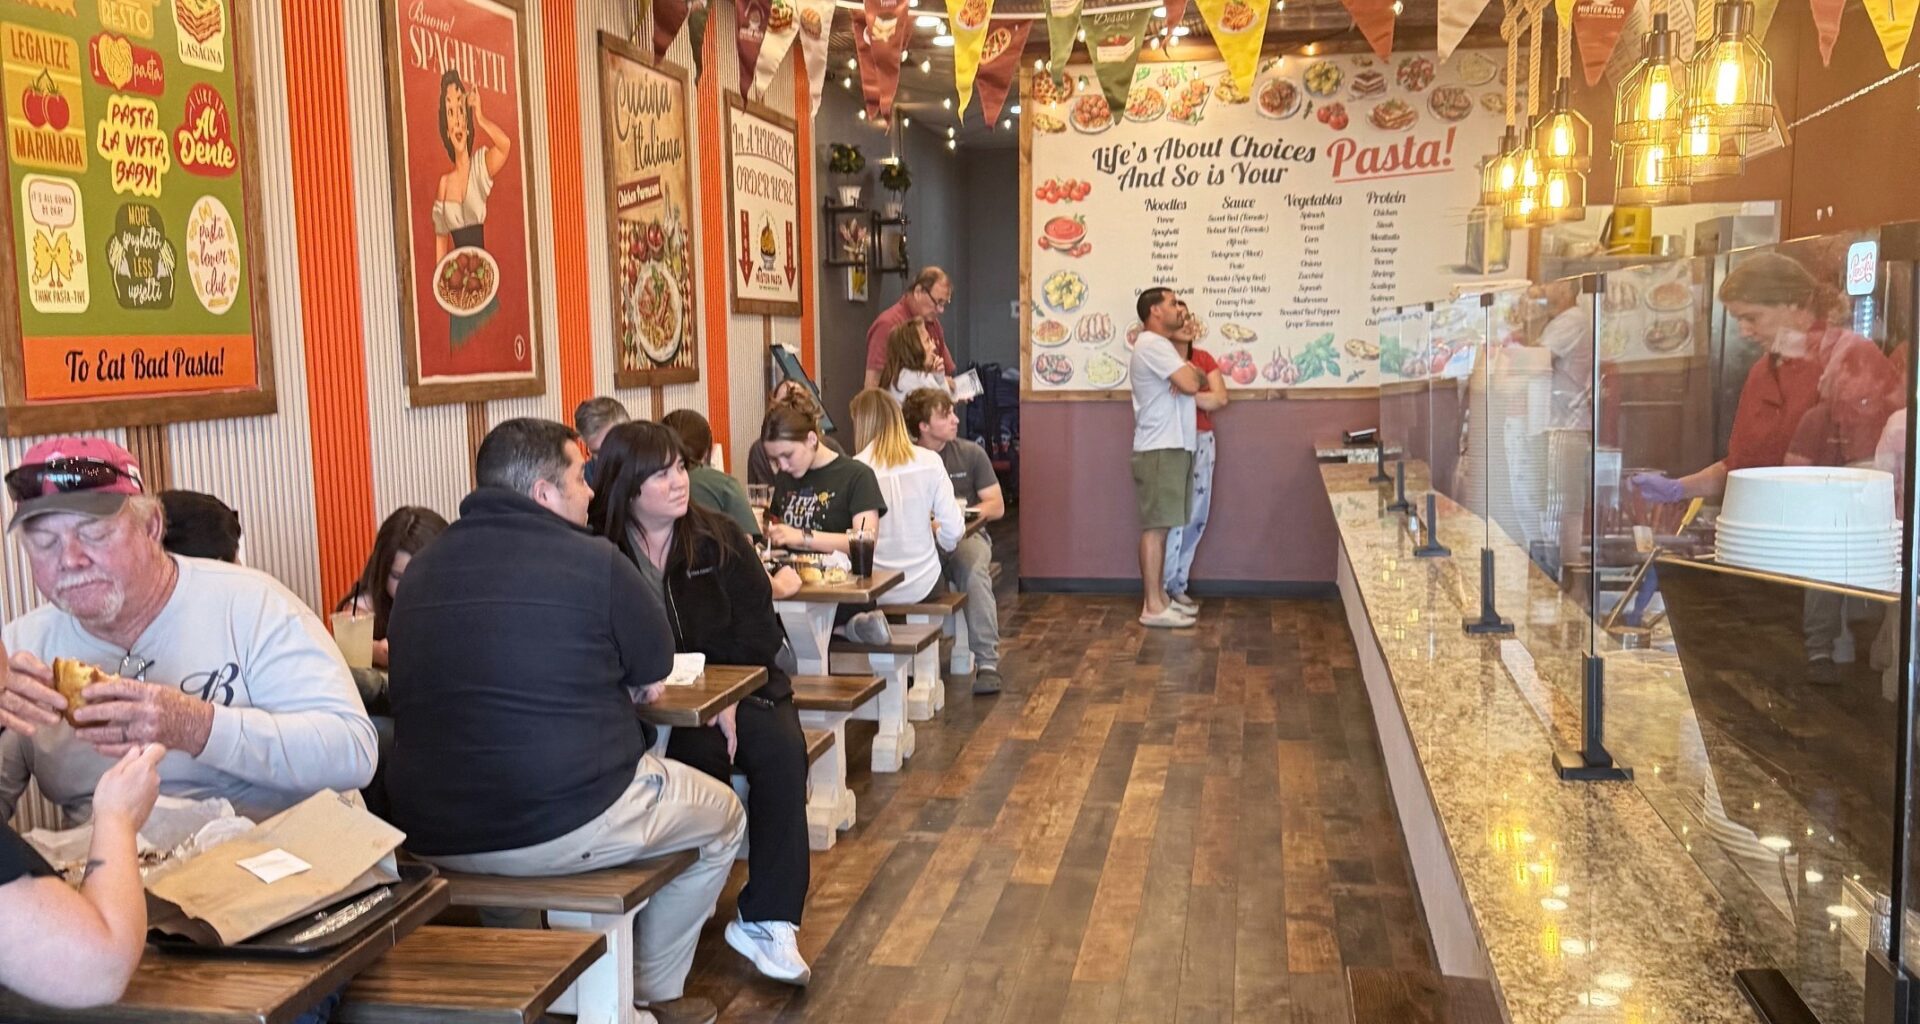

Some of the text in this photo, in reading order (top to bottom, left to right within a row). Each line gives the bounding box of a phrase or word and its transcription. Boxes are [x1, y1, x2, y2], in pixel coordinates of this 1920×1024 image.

[408, 0, 455, 33] Buono!
[1577, 5, 1625, 15] MISTER PASTA
[10, 29, 70, 70] LEGALIZE
[409, 24, 507, 95] SPAGHETTI
[133, 55, 163, 87] pasta
[111, 104, 154, 129] PASTA
[614, 70, 672, 142] Cucina
[192, 105, 218, 141] Al
[14, 129, 83, 165] MARINARA
[101, 128, 120, 151] LA
[178, 130, 236, 168] Dente
[632, 118, 682, 171] Italiana
[1092, 126, 1456, 178] Life's About Choices Pasta!
[115, 161, 158, 190] BABY!
[736, 164, 794, 206] ORDER HERE
[1118, 161, 1289, 192] And So is Your
[1144, 198, 1187, 212] Noodles
[1222, 195, 1256, 210] Sauce
[1283, 193, 1343, 211] Vegetables
[1366, 190, 1406, 205] Protein
[128, 204, 150, 226] MORE
[133, 258, 153, 277] LESS
[200, 241, 227, 267] lover
[205, 266, 226, 296] club
[65, 347, 225, 383] To Eat Bad Pasta!
[784, 510, 813, 529] OUT
